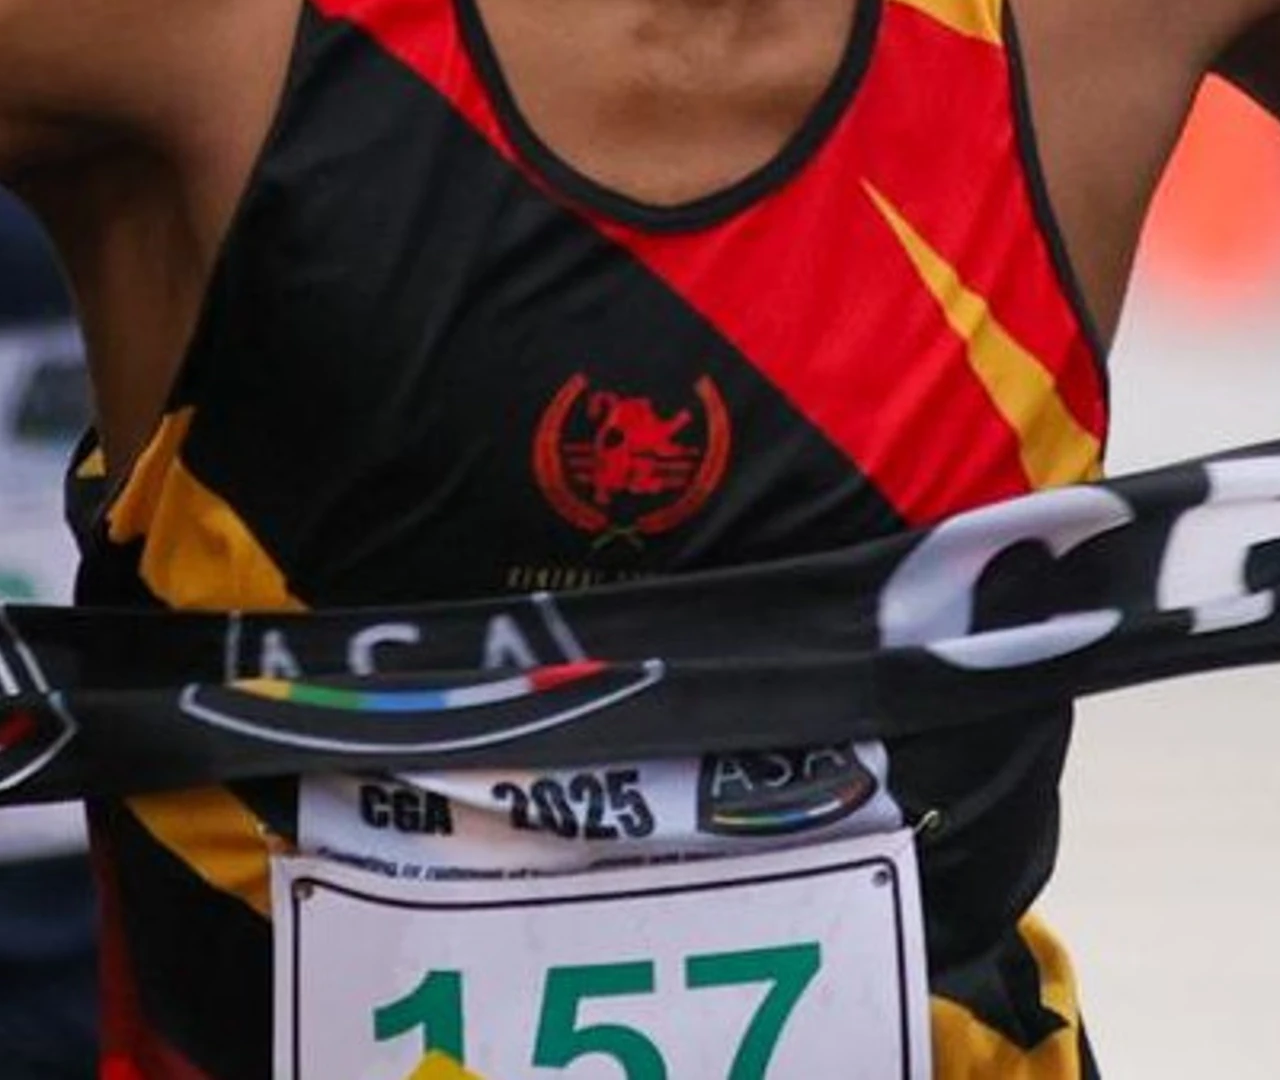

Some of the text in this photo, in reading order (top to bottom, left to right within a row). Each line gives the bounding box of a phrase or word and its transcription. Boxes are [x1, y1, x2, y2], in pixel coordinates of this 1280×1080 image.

[359, 769, 656, 840] CGA 2025
[373, 941, 822, 1080] 157
